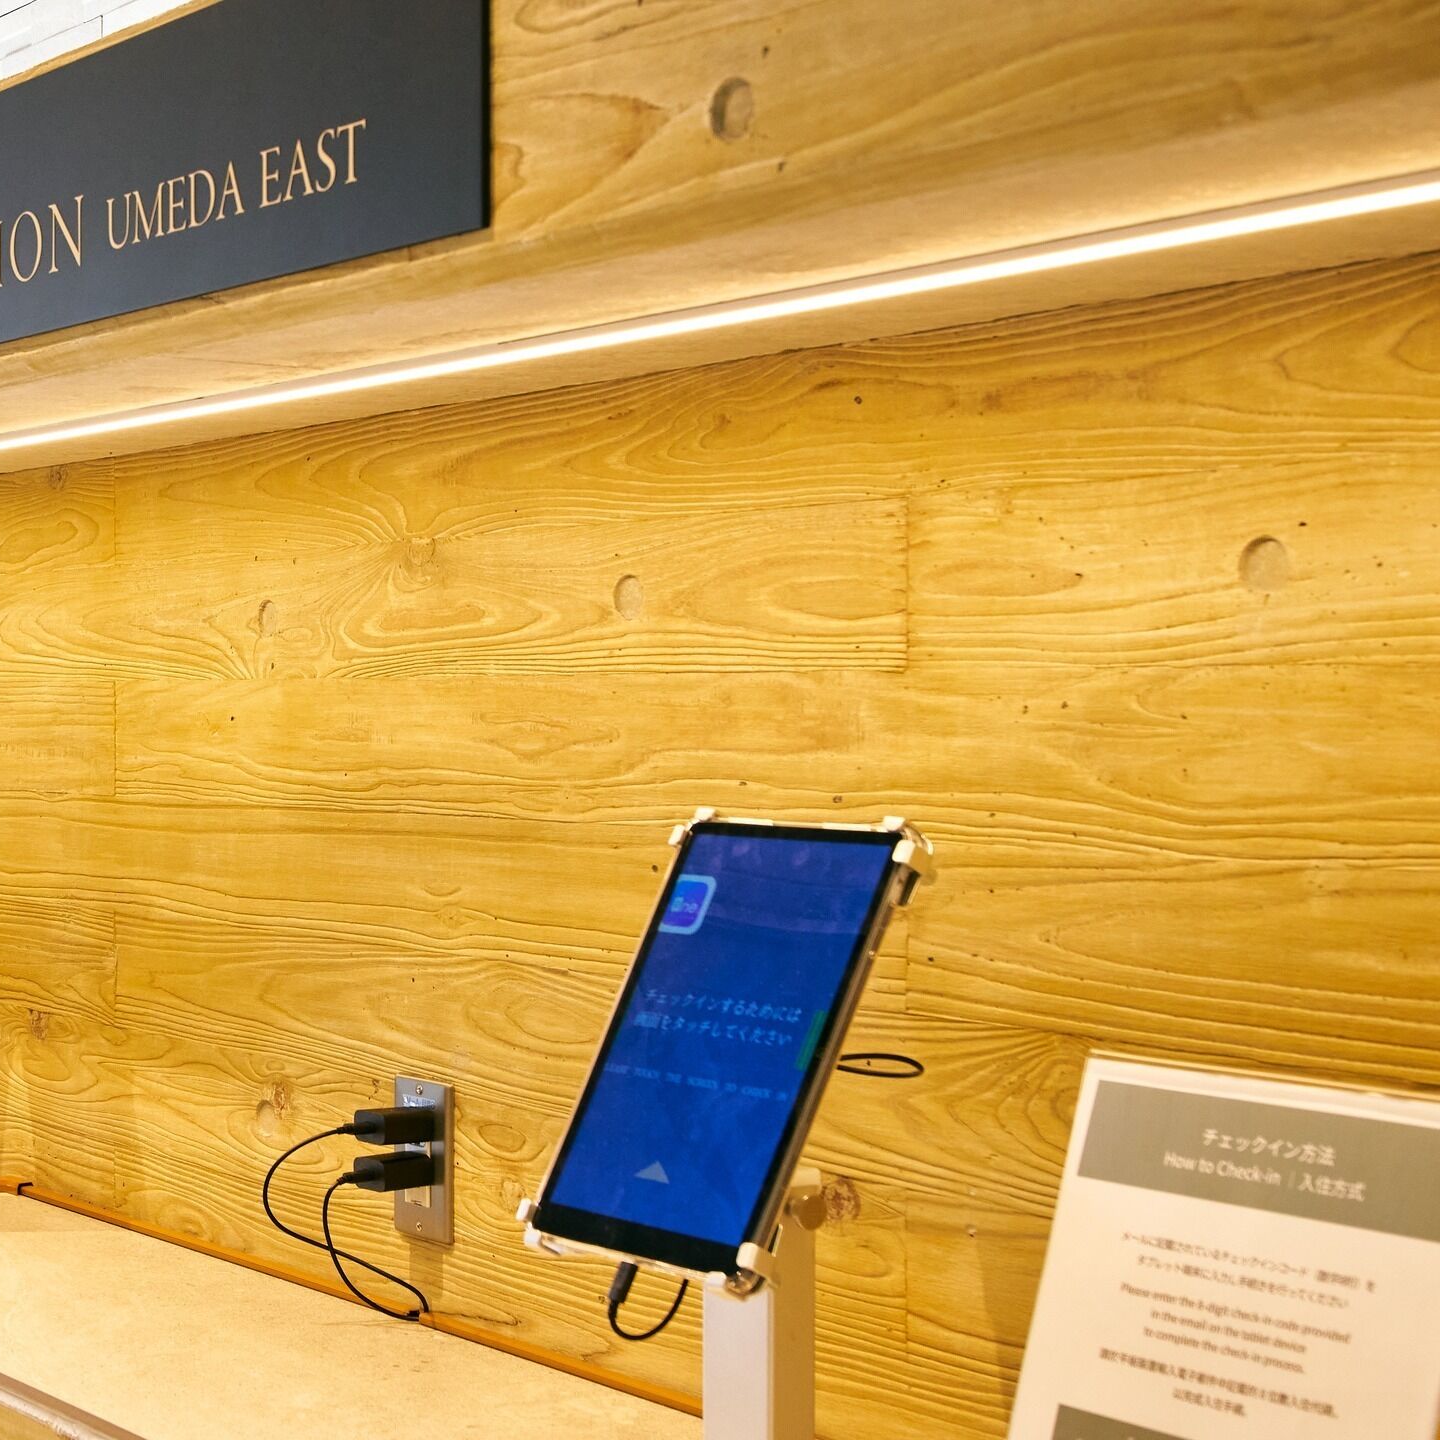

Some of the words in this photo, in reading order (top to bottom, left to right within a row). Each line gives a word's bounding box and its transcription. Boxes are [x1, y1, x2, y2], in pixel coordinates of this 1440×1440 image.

[106, 160, 245, 250] UMEDA
[259, 117, 367, 209] EAST
[1201, 1127, 1337, 1167] チェックイン方法
[1162, 1150, 1198, 1171] How
[1197, 1157, 1216, 1175] to
[1216, 1159, 1282, 1186] Check-in
[1298, 1172, 1367, 1202] 入住方式
[1120, 1281, 1151, 1299] Please
[1178, 1295, 1196, 1308] the
[1300, 1325, 1351, 1345] provided
[1161, 1310, 1178, 1323] the
[1179, 1317, 1207, 1332] email
[1222, 1325, 1239, 1338] the
